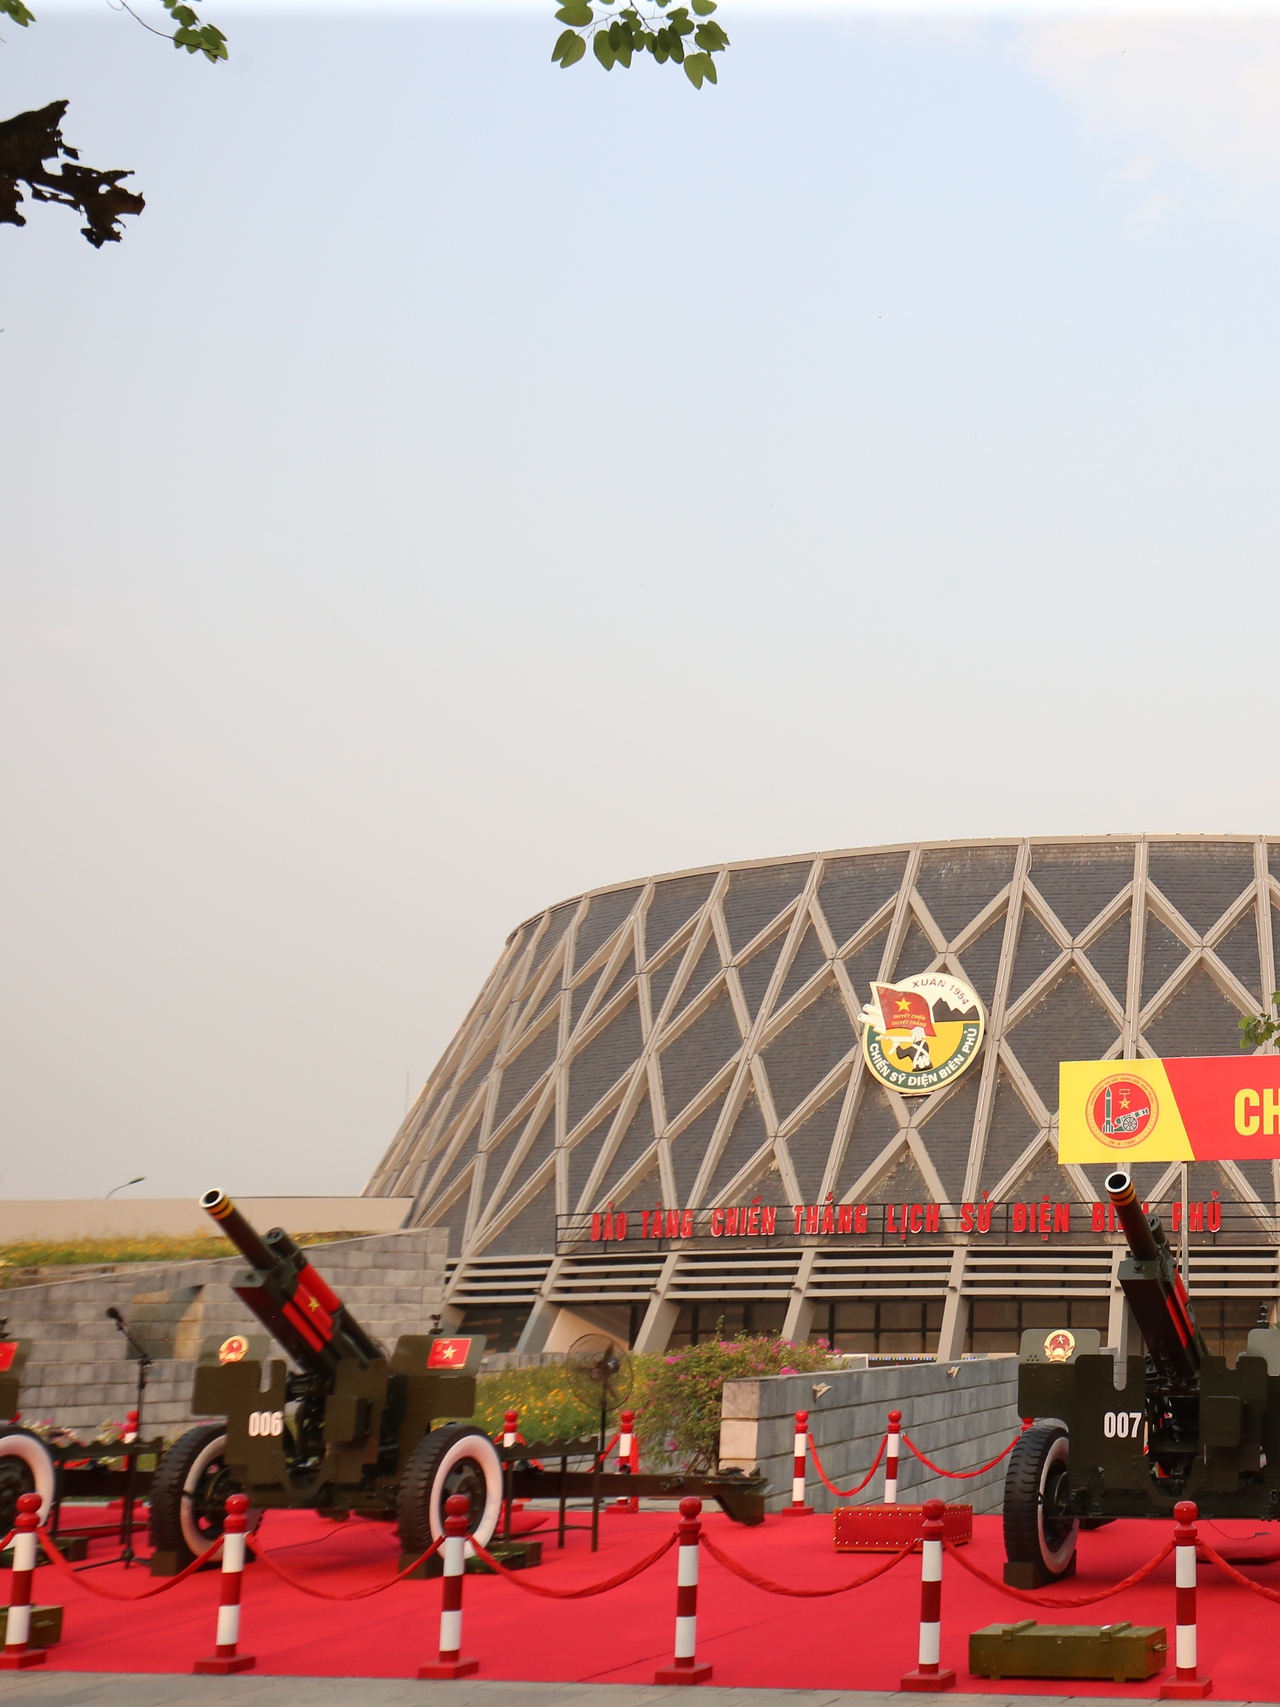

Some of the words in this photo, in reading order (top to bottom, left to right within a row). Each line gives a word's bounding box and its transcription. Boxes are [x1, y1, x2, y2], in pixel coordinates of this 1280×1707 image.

[912, 976, 947, 989] XUÂN
[949, 984, 969, 1005] 1954
[869, 1043, 891, 1078] CHIẾN
[889, 1071, 907, 1085] SỸ
[907, 1072, 938, 1087] ĐIỆN
[938, 1054, 965, 1079] BIÊN
[961, 1027, 978, 1054] PHỦ
[590, 1200, 627, 1241] BẢO
[641, 1200, 694, 1239] TÀNG
[711, 1195, 777, 1237] CHIẾN
[793, 1191, 868, 1235] THẮNG
[887, 1203, 940, 1240] LỊCH
[960, 1190, 995, 1234] SỬ
[1012, 1195, 1071, 1241] ĐIỆN
[1091, 1202, 1150, 1232] BI
[1171, 1189, 1222, 1233] PHỦ
[248, 1410, 284, 1437] 006
[1103, 1411, 1142, 1438] 007
